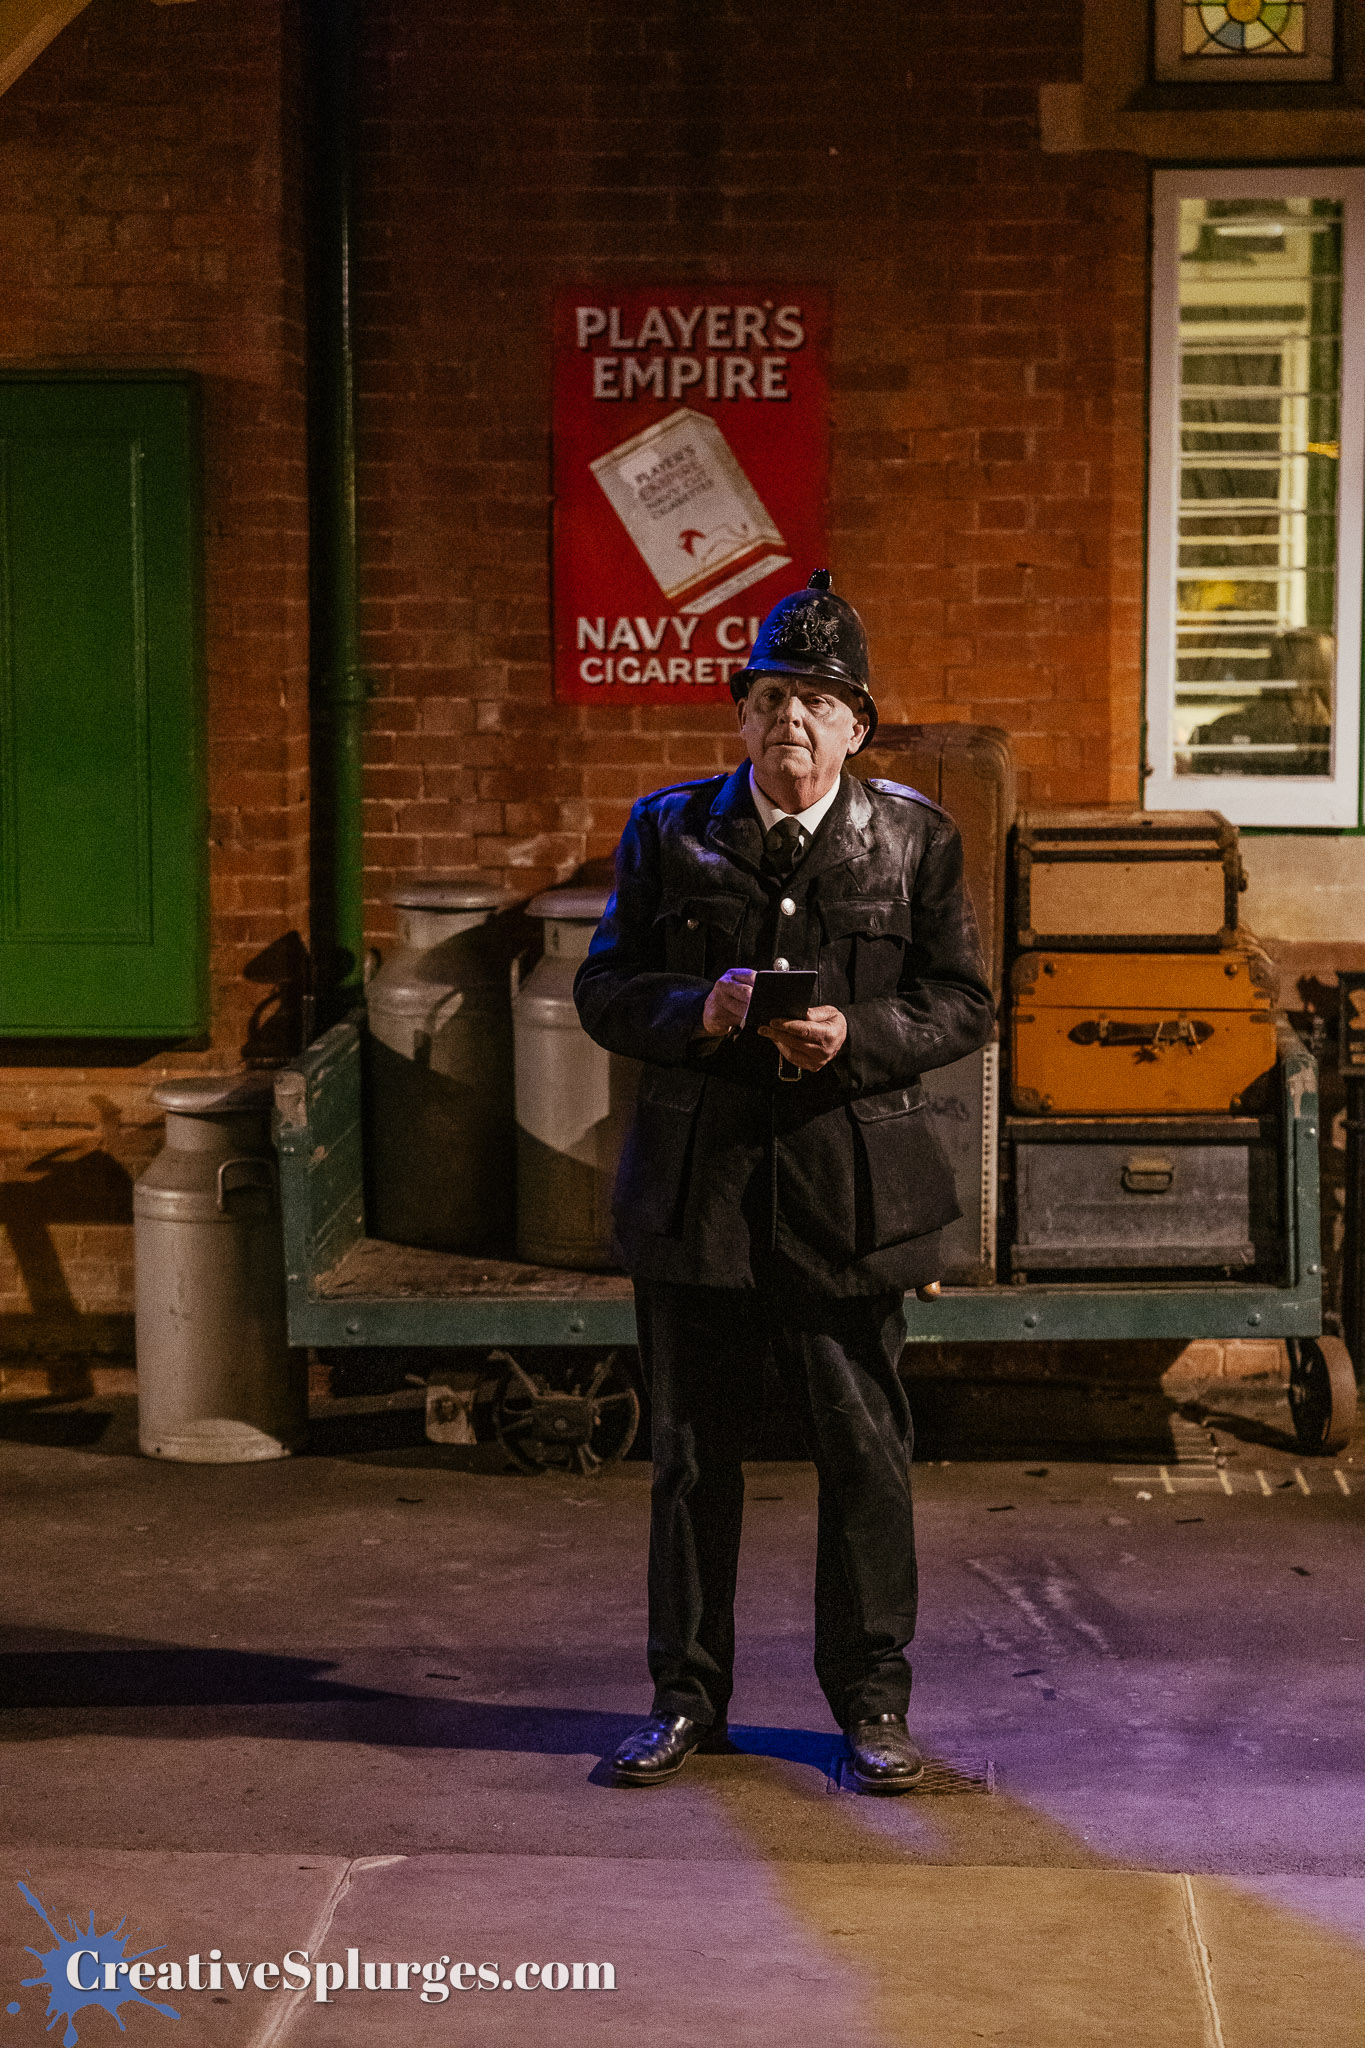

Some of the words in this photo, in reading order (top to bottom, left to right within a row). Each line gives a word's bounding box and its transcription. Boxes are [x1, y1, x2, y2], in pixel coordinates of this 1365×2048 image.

[575, 301, 804, 348] PLAYER'S
[593, 356, 787, 398] EMPIRE
[577, 616, 699, 650] NAVY
